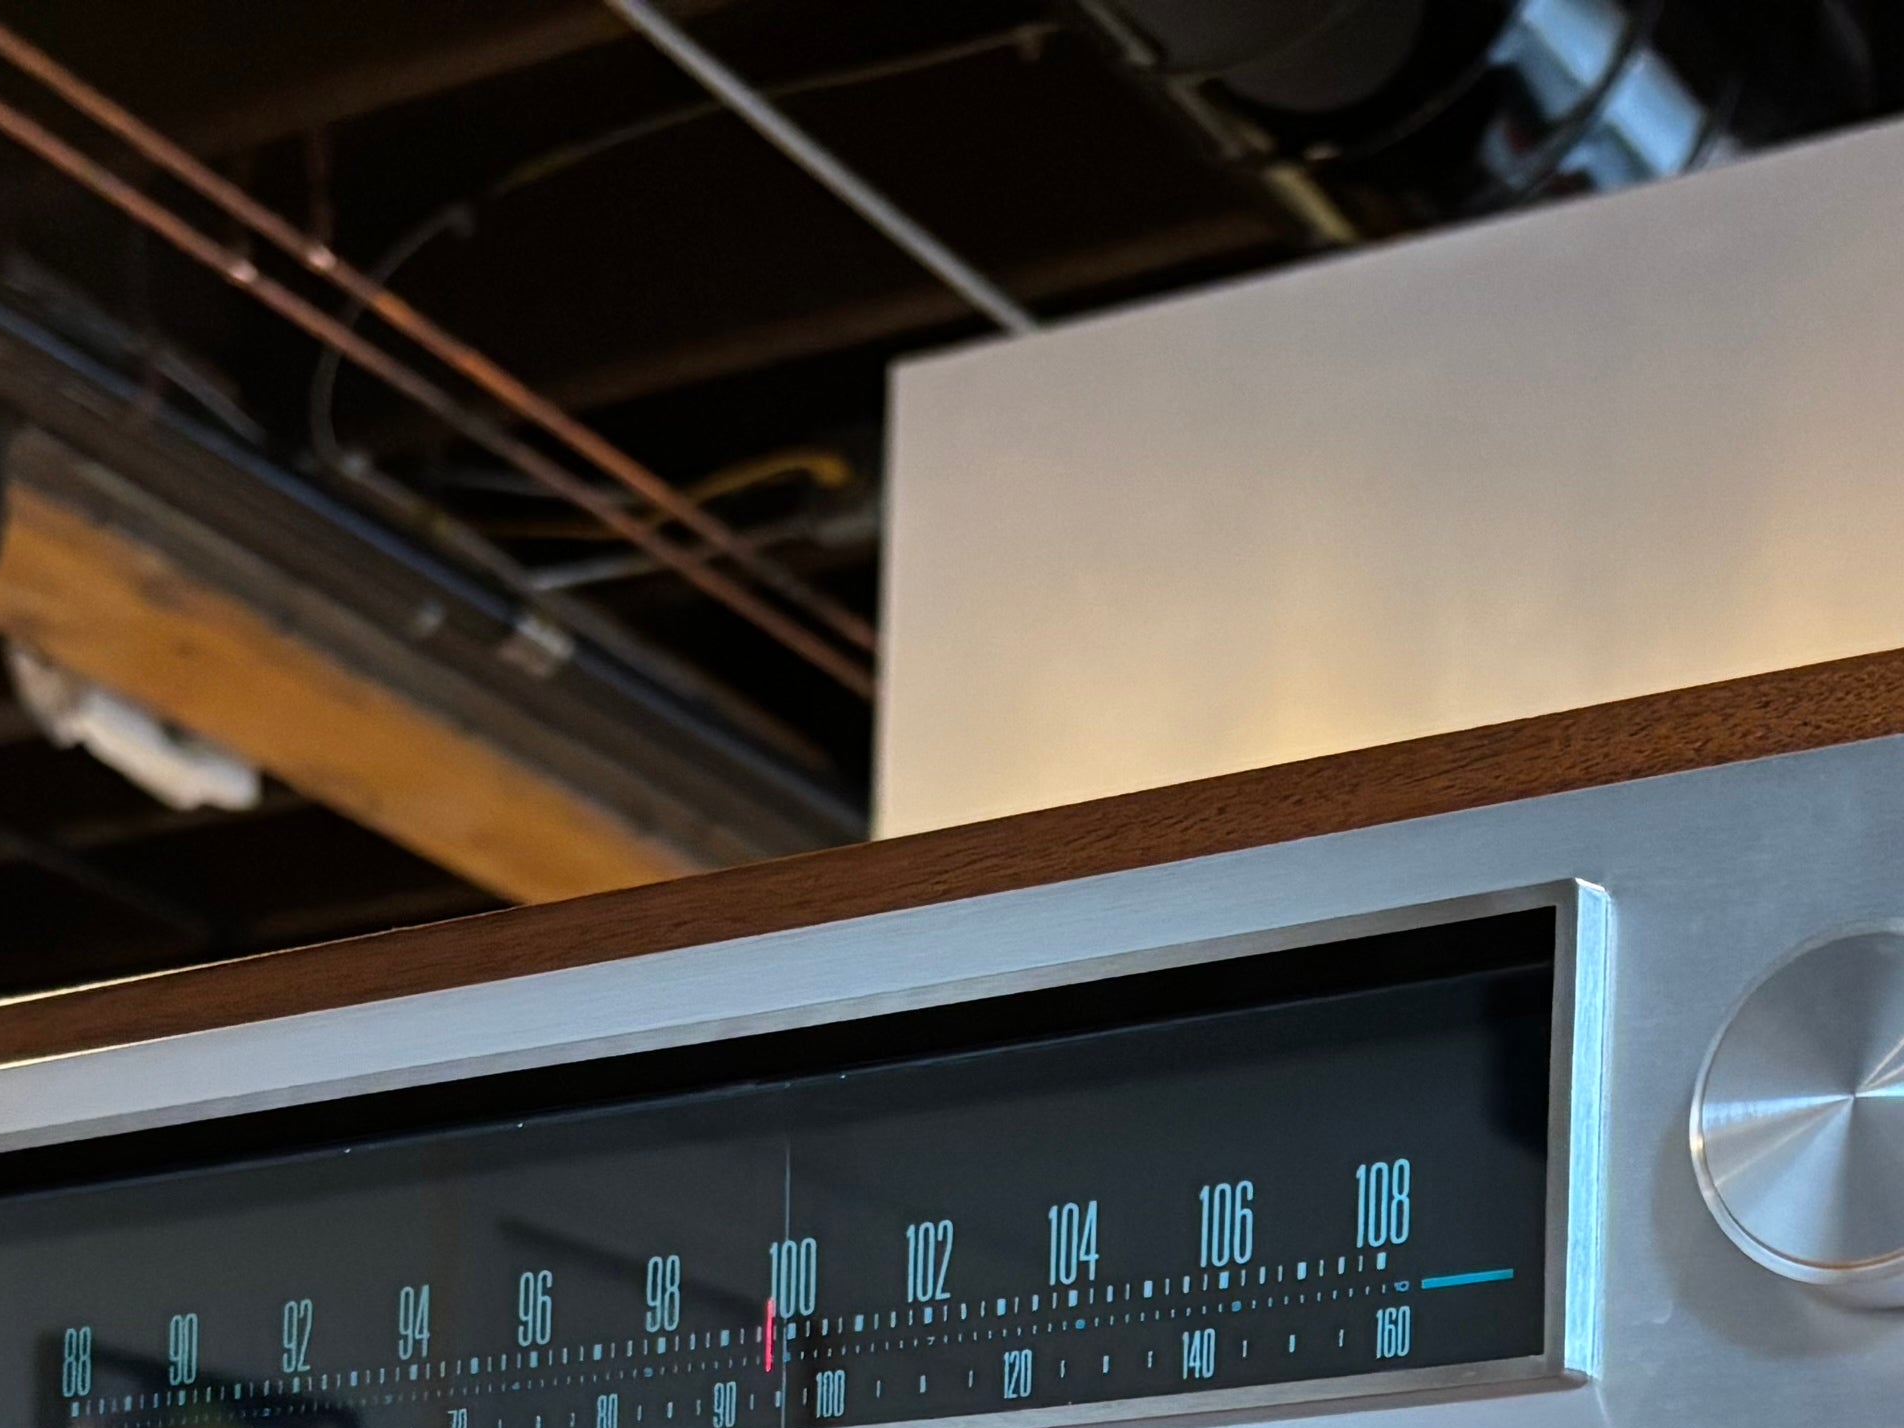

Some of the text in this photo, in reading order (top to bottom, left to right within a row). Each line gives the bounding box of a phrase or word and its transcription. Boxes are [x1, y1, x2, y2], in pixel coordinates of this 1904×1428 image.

[62, 1158, 1412, 1398] 88 90 92 94 96 98 100 102 104 106 108
[815, 1369, 846, 1420] 100
[1002, 1348, 1033, 1400] 120
[1182, 1328, 1216, 1381] 140
[1375, 1305, 1411, 1359] 160
